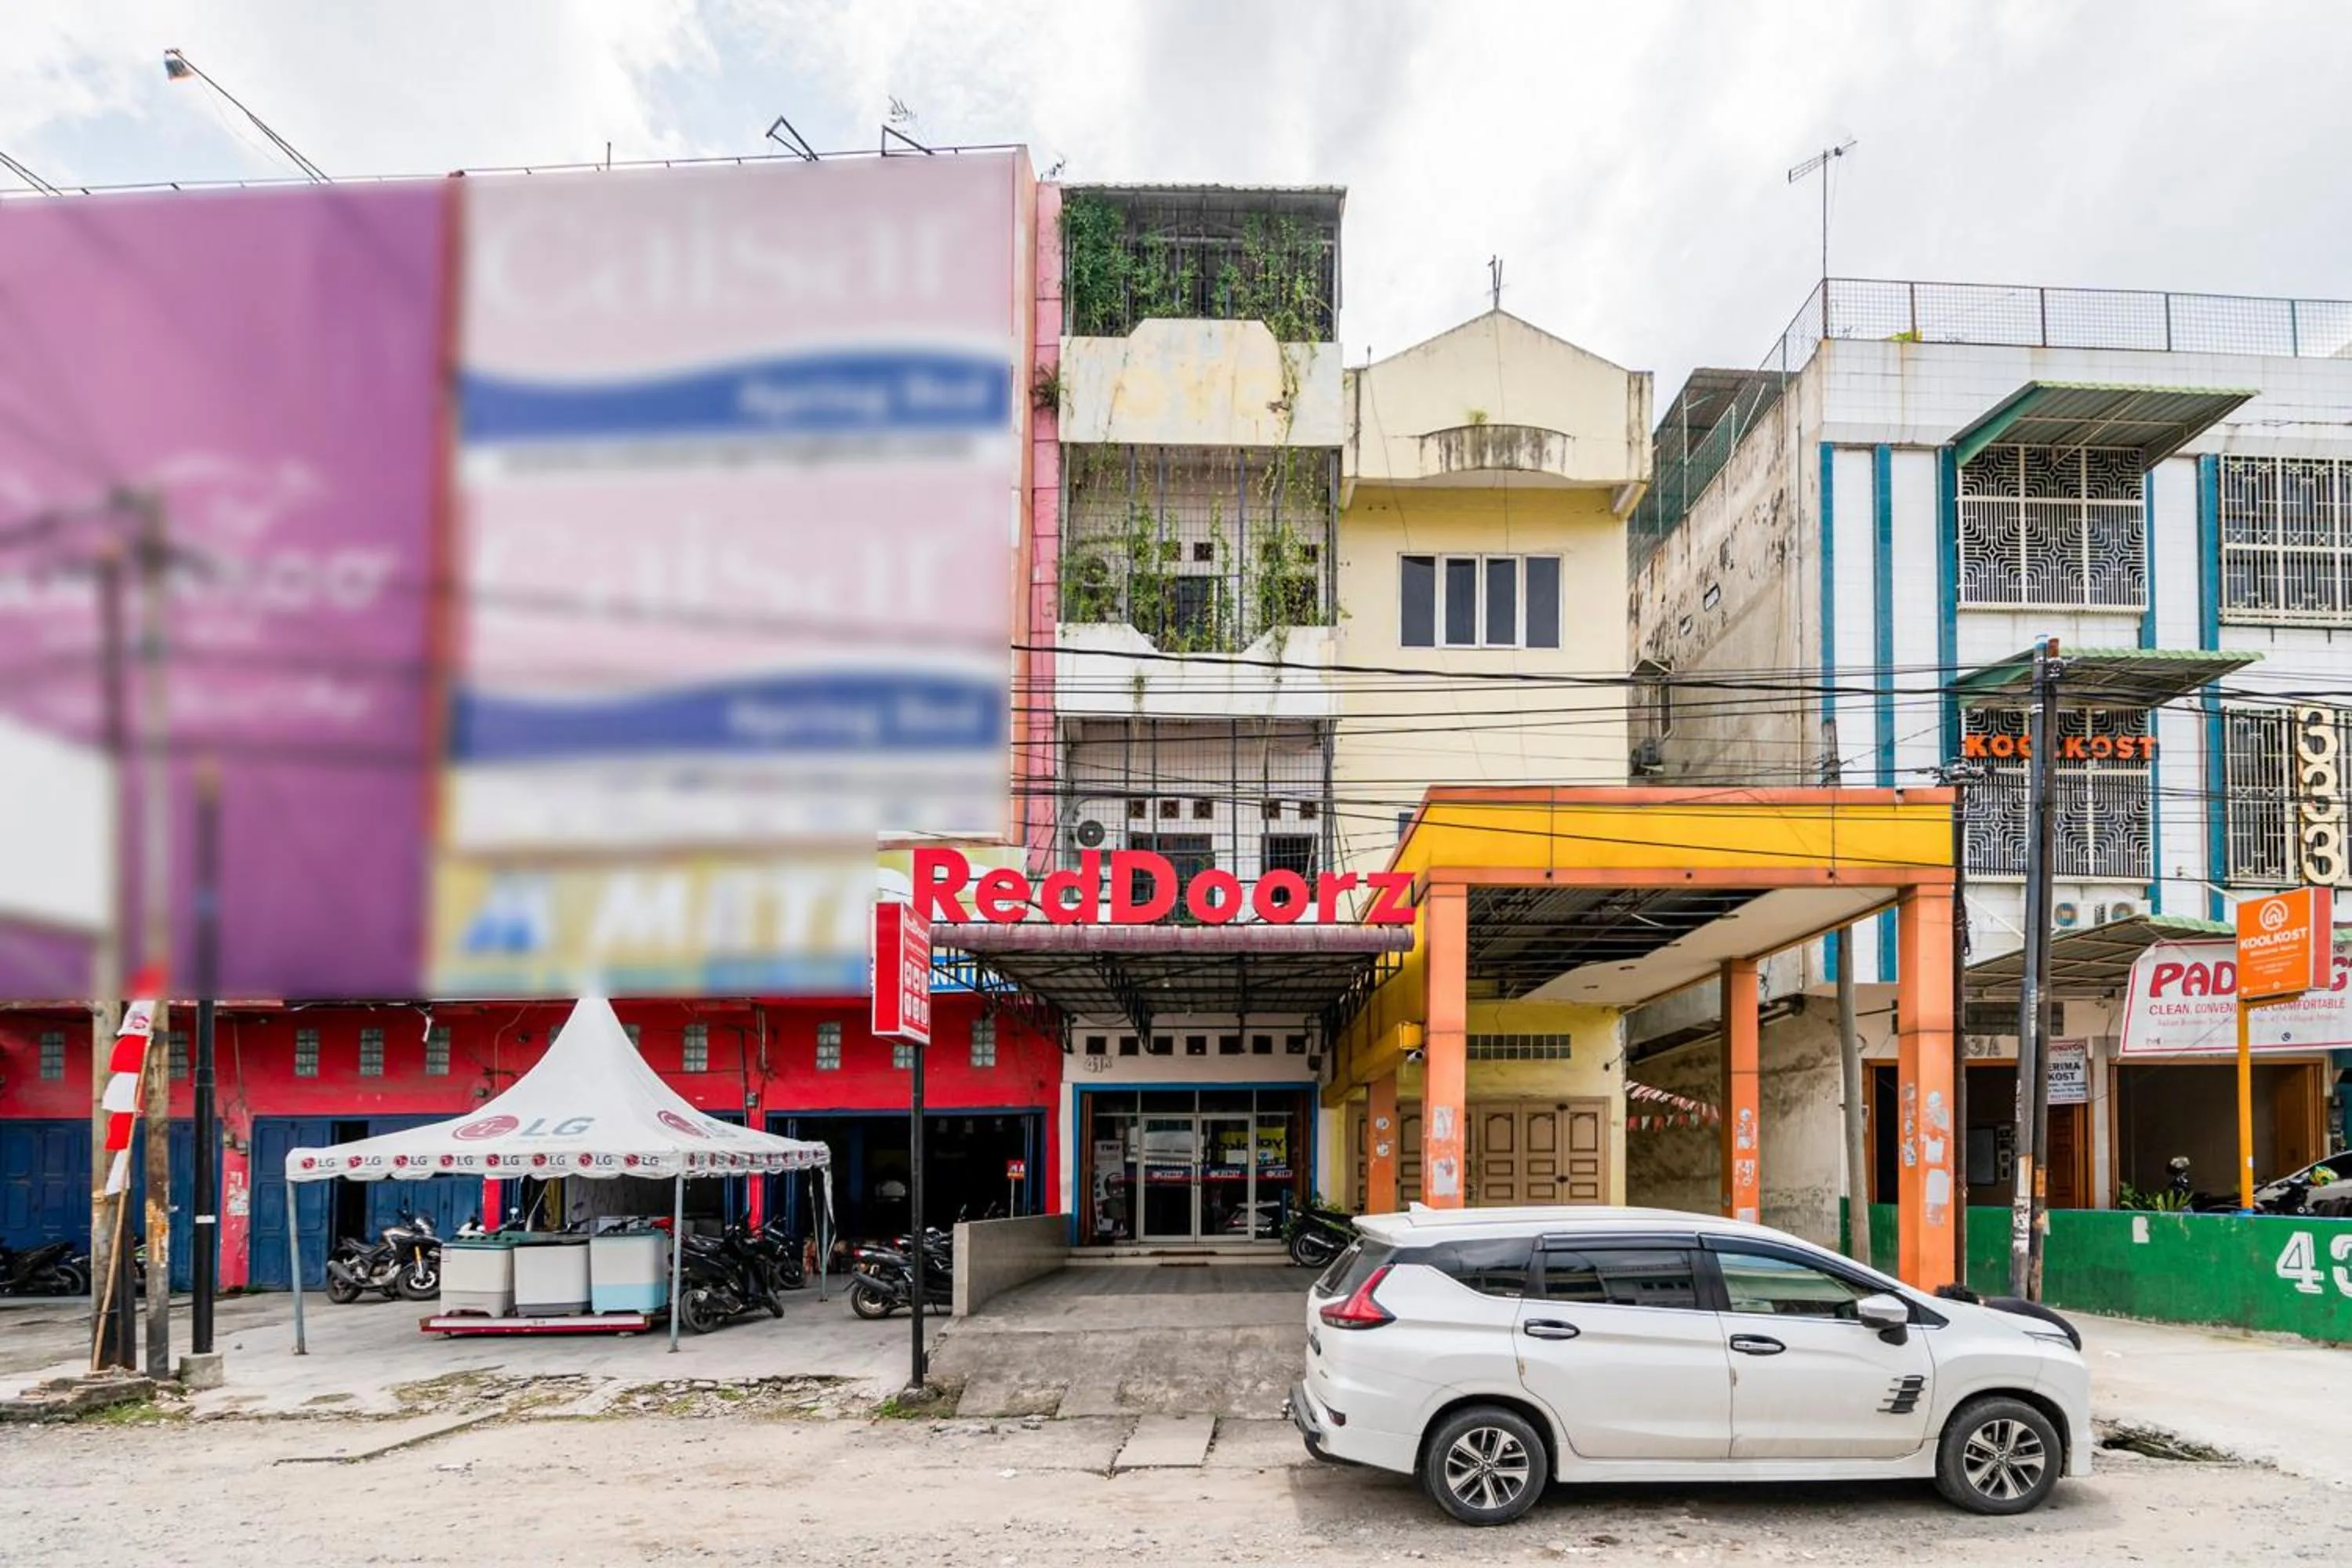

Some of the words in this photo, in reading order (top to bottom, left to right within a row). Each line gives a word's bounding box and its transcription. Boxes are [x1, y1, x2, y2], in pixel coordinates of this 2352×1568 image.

[1963, 734, 2157, 759] KOOKOST
[913, 848, 1417, 924] RedDoorz
[2240, 927, 2308, 950] KOOLKOST
[520, 1117, 596, 1136] LG
[318, 1158, 336, 1168] LG
[365, 1156, 382, 1166] LG
[410, 1156, 427, 1166] LG
[457, 1156, 474, 1166] LG
[503, 1156, 520, 1166] LG
[550, 1156, 565, 1166] LG
[596, 1156, 613, 1166] LG
[642, 1156, 659, 1166] LG
